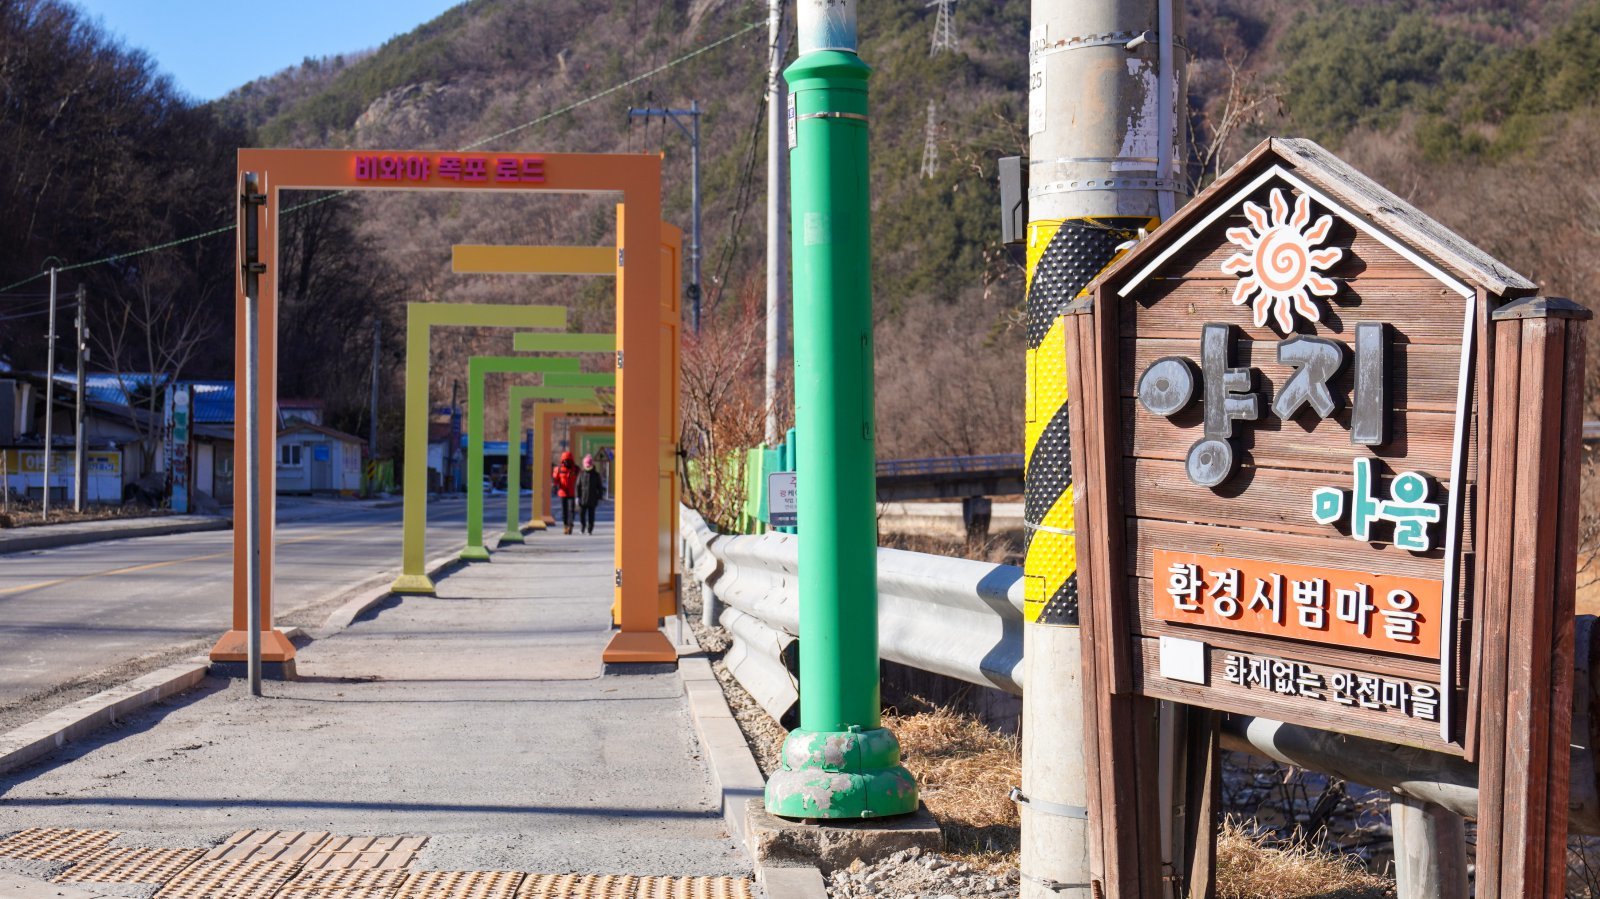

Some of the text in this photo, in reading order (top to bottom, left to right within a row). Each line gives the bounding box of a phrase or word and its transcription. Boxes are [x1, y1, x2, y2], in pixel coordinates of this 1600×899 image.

[355, 156, 545, 182] 비와야 폭포 로드
[1137, 322, 1384, 488] 양지
[1312, 456, 1440, 552] 마을
[1166, 563, 1420, 642] 환경시범마을
[1223, 654, 1437, 720] 화재없는 안전마을
